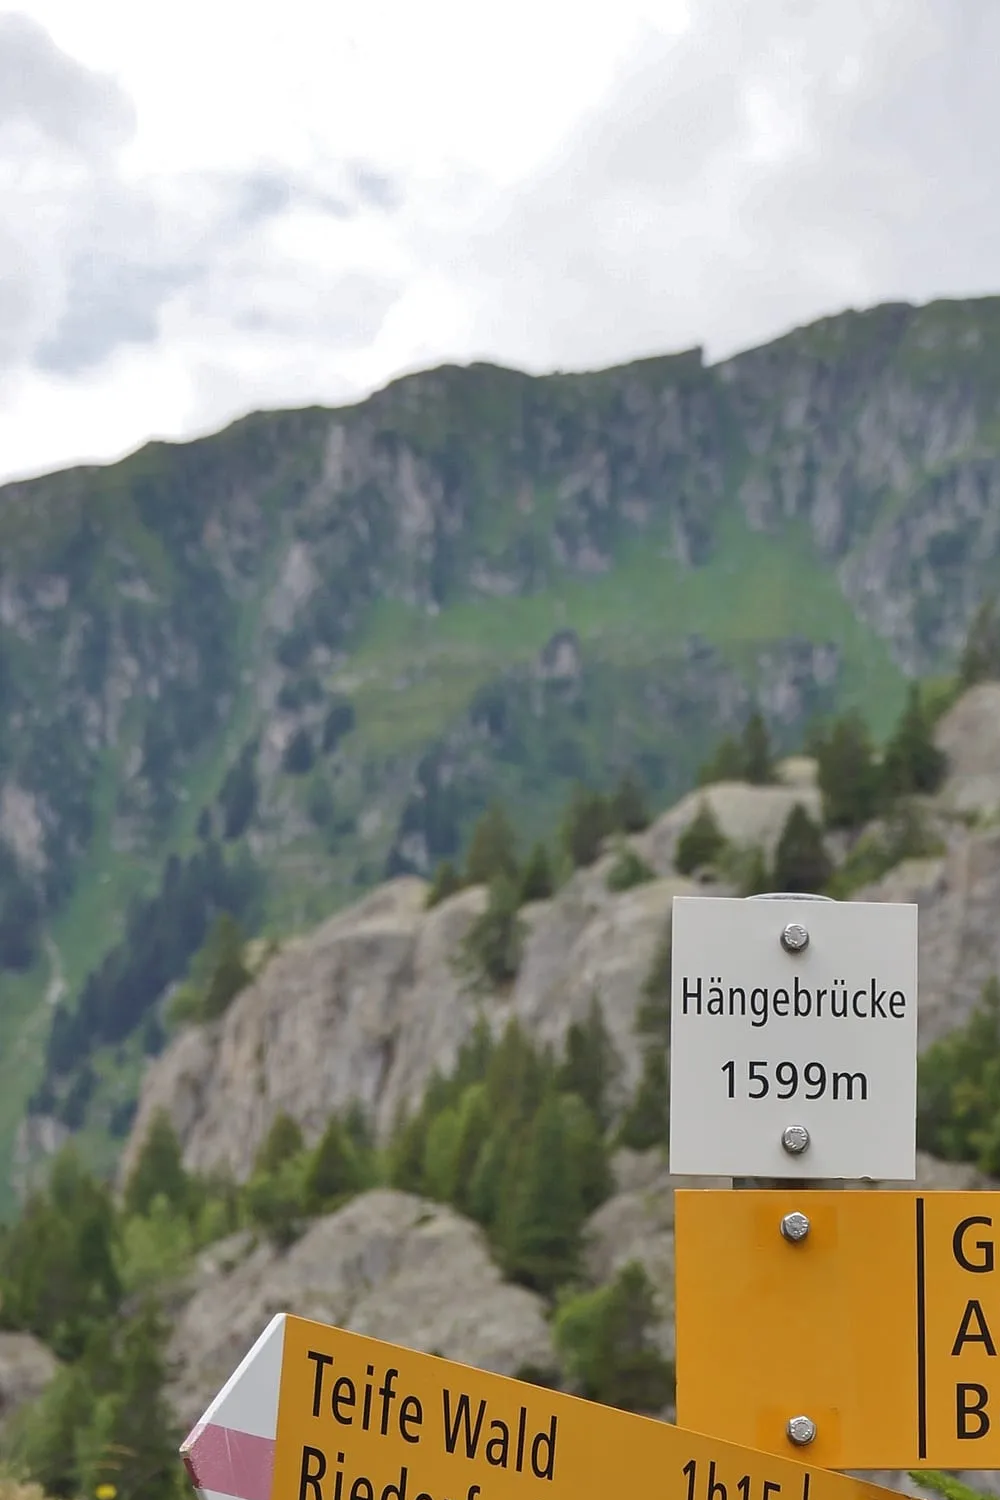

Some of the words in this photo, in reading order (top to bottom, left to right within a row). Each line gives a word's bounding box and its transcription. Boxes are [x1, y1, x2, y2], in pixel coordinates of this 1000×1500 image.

[682, 976, 907, 1027] Hängebrücke
[721, 1060, 868, 1100] 1599m
[307, 1350, 423, 1444] Teife
[442, 1388, 558, 1481] Wald
